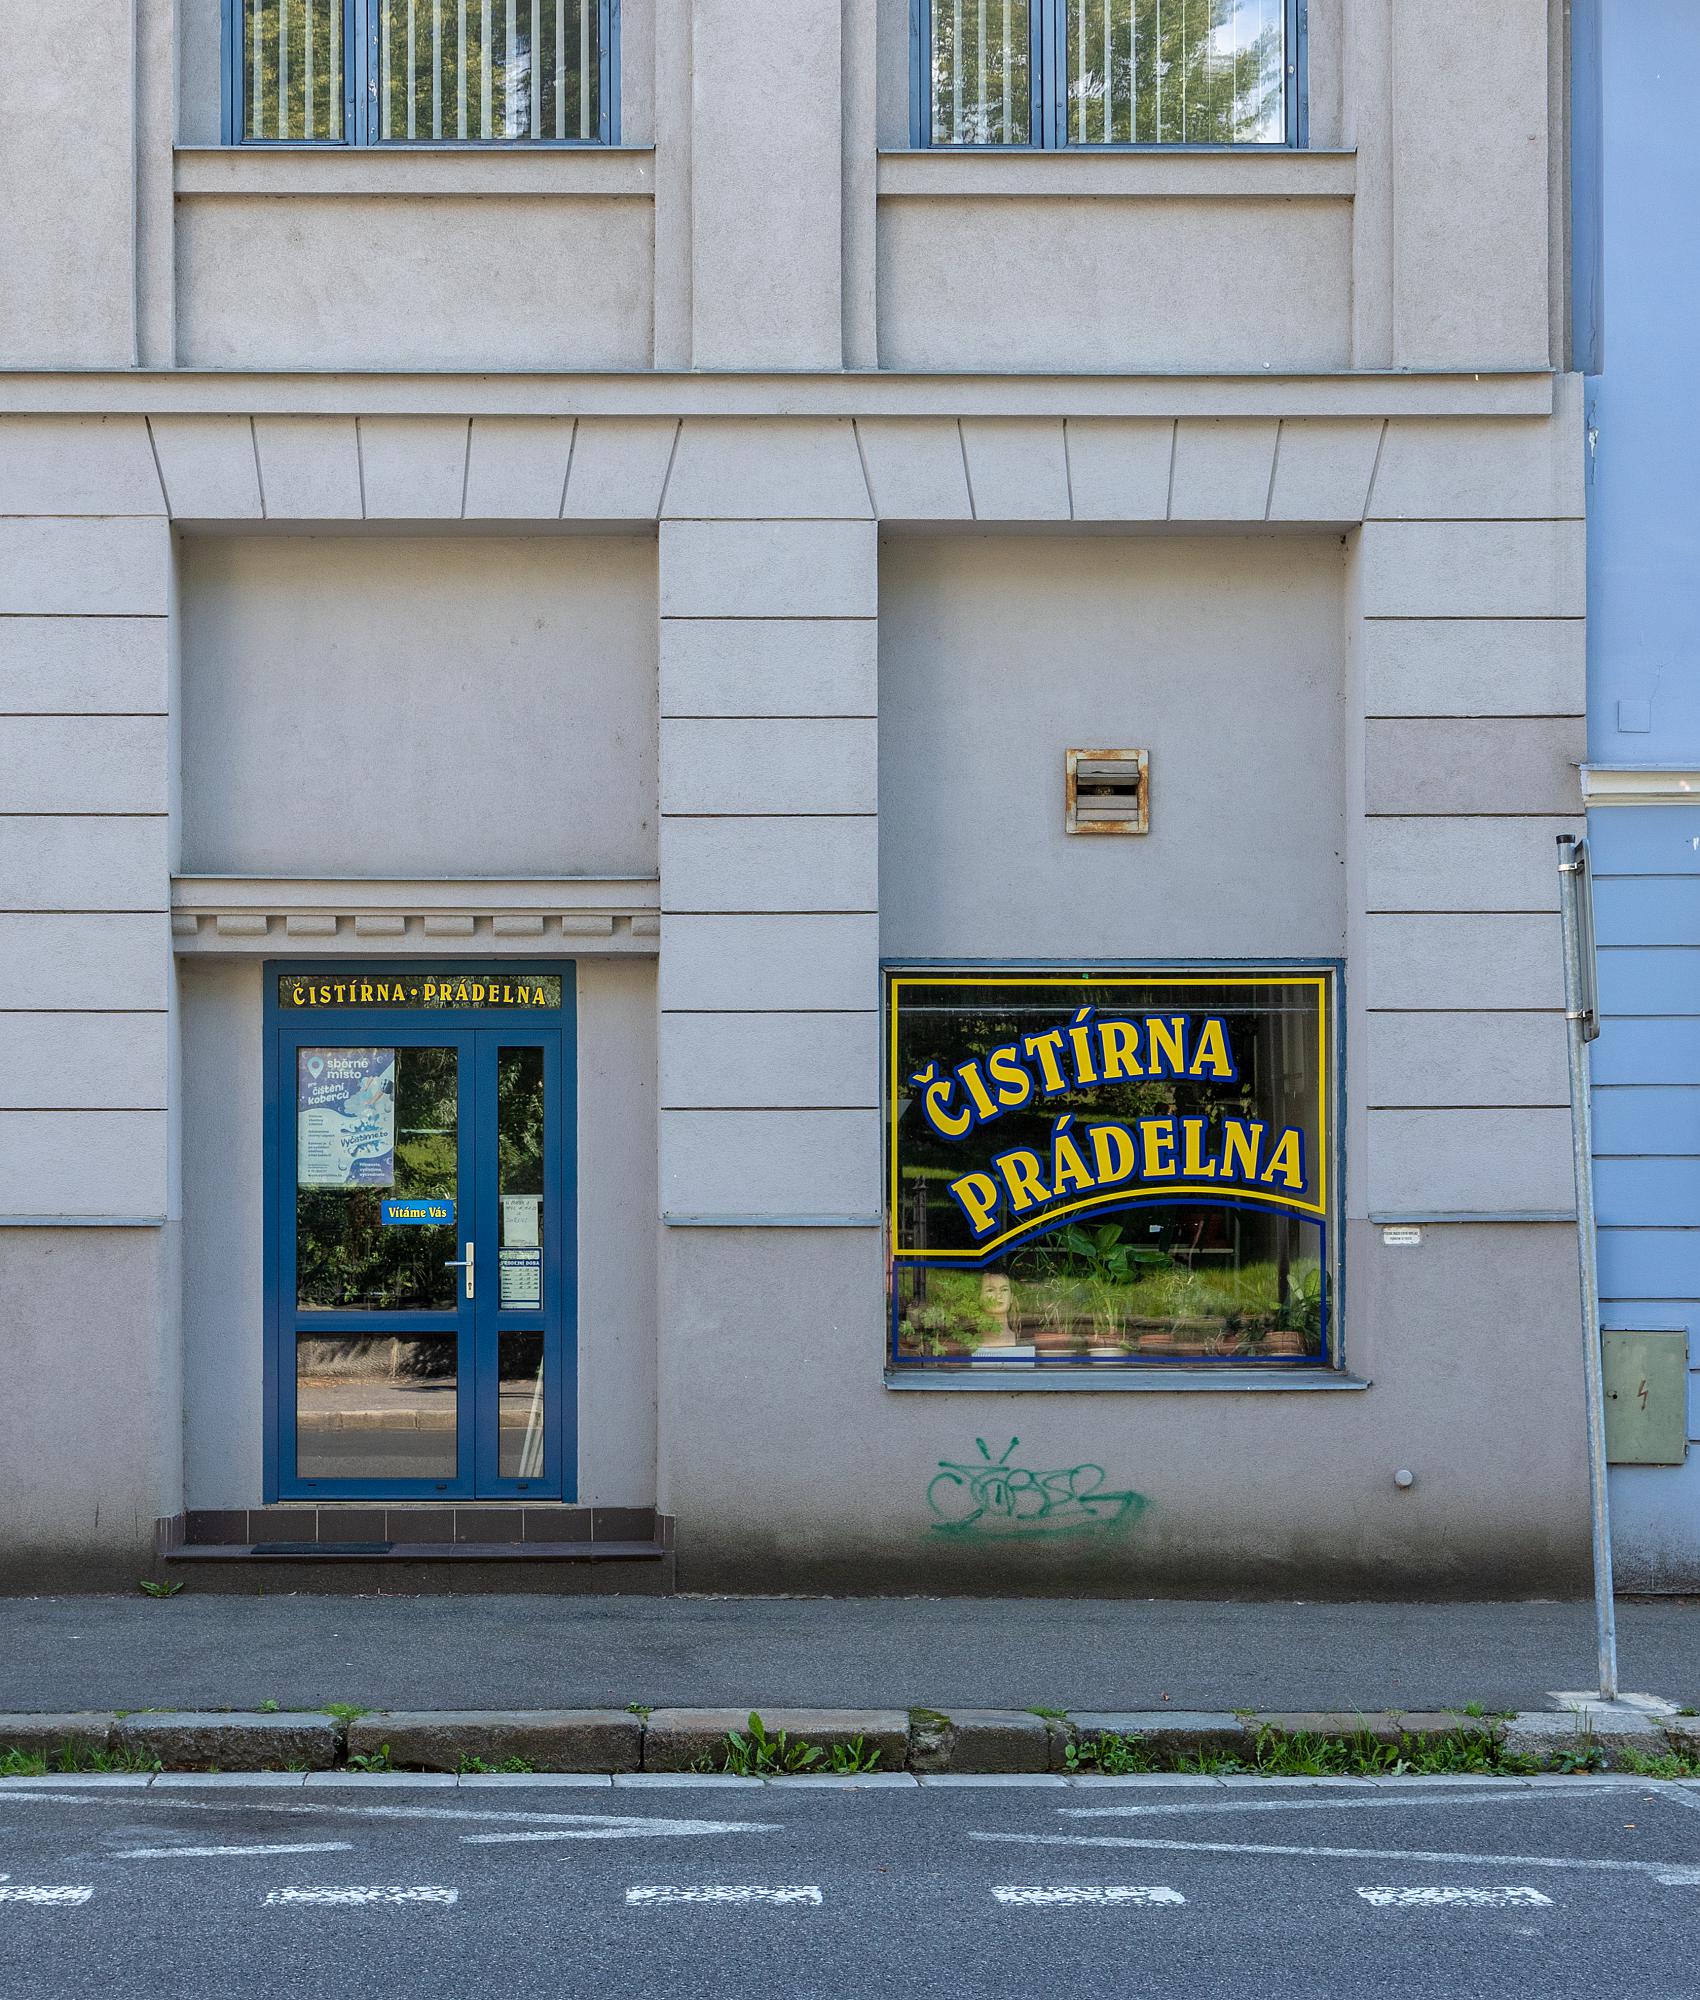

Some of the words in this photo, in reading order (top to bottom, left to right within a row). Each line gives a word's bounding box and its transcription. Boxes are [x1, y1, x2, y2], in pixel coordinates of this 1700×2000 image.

[292, 979, 406, 1005] ČISTÍRNA
[423, 978, 546, 1005] PRÁDELNA
[327, 1058, 369, 1069] sběrné
[327, 1067, 362, 1079] místo
[912, 1006, 1236, 1137] ČISTÍRNA
[312, 1083, 345, 1096] čištění
[307, 1090, 350, 1105] koberců
[950, 1115, 1307, 1233] PRÁDELNA
[388, 1206, 426, 1218] Vítáme
[428, 1206, 447, 1218] Vás
